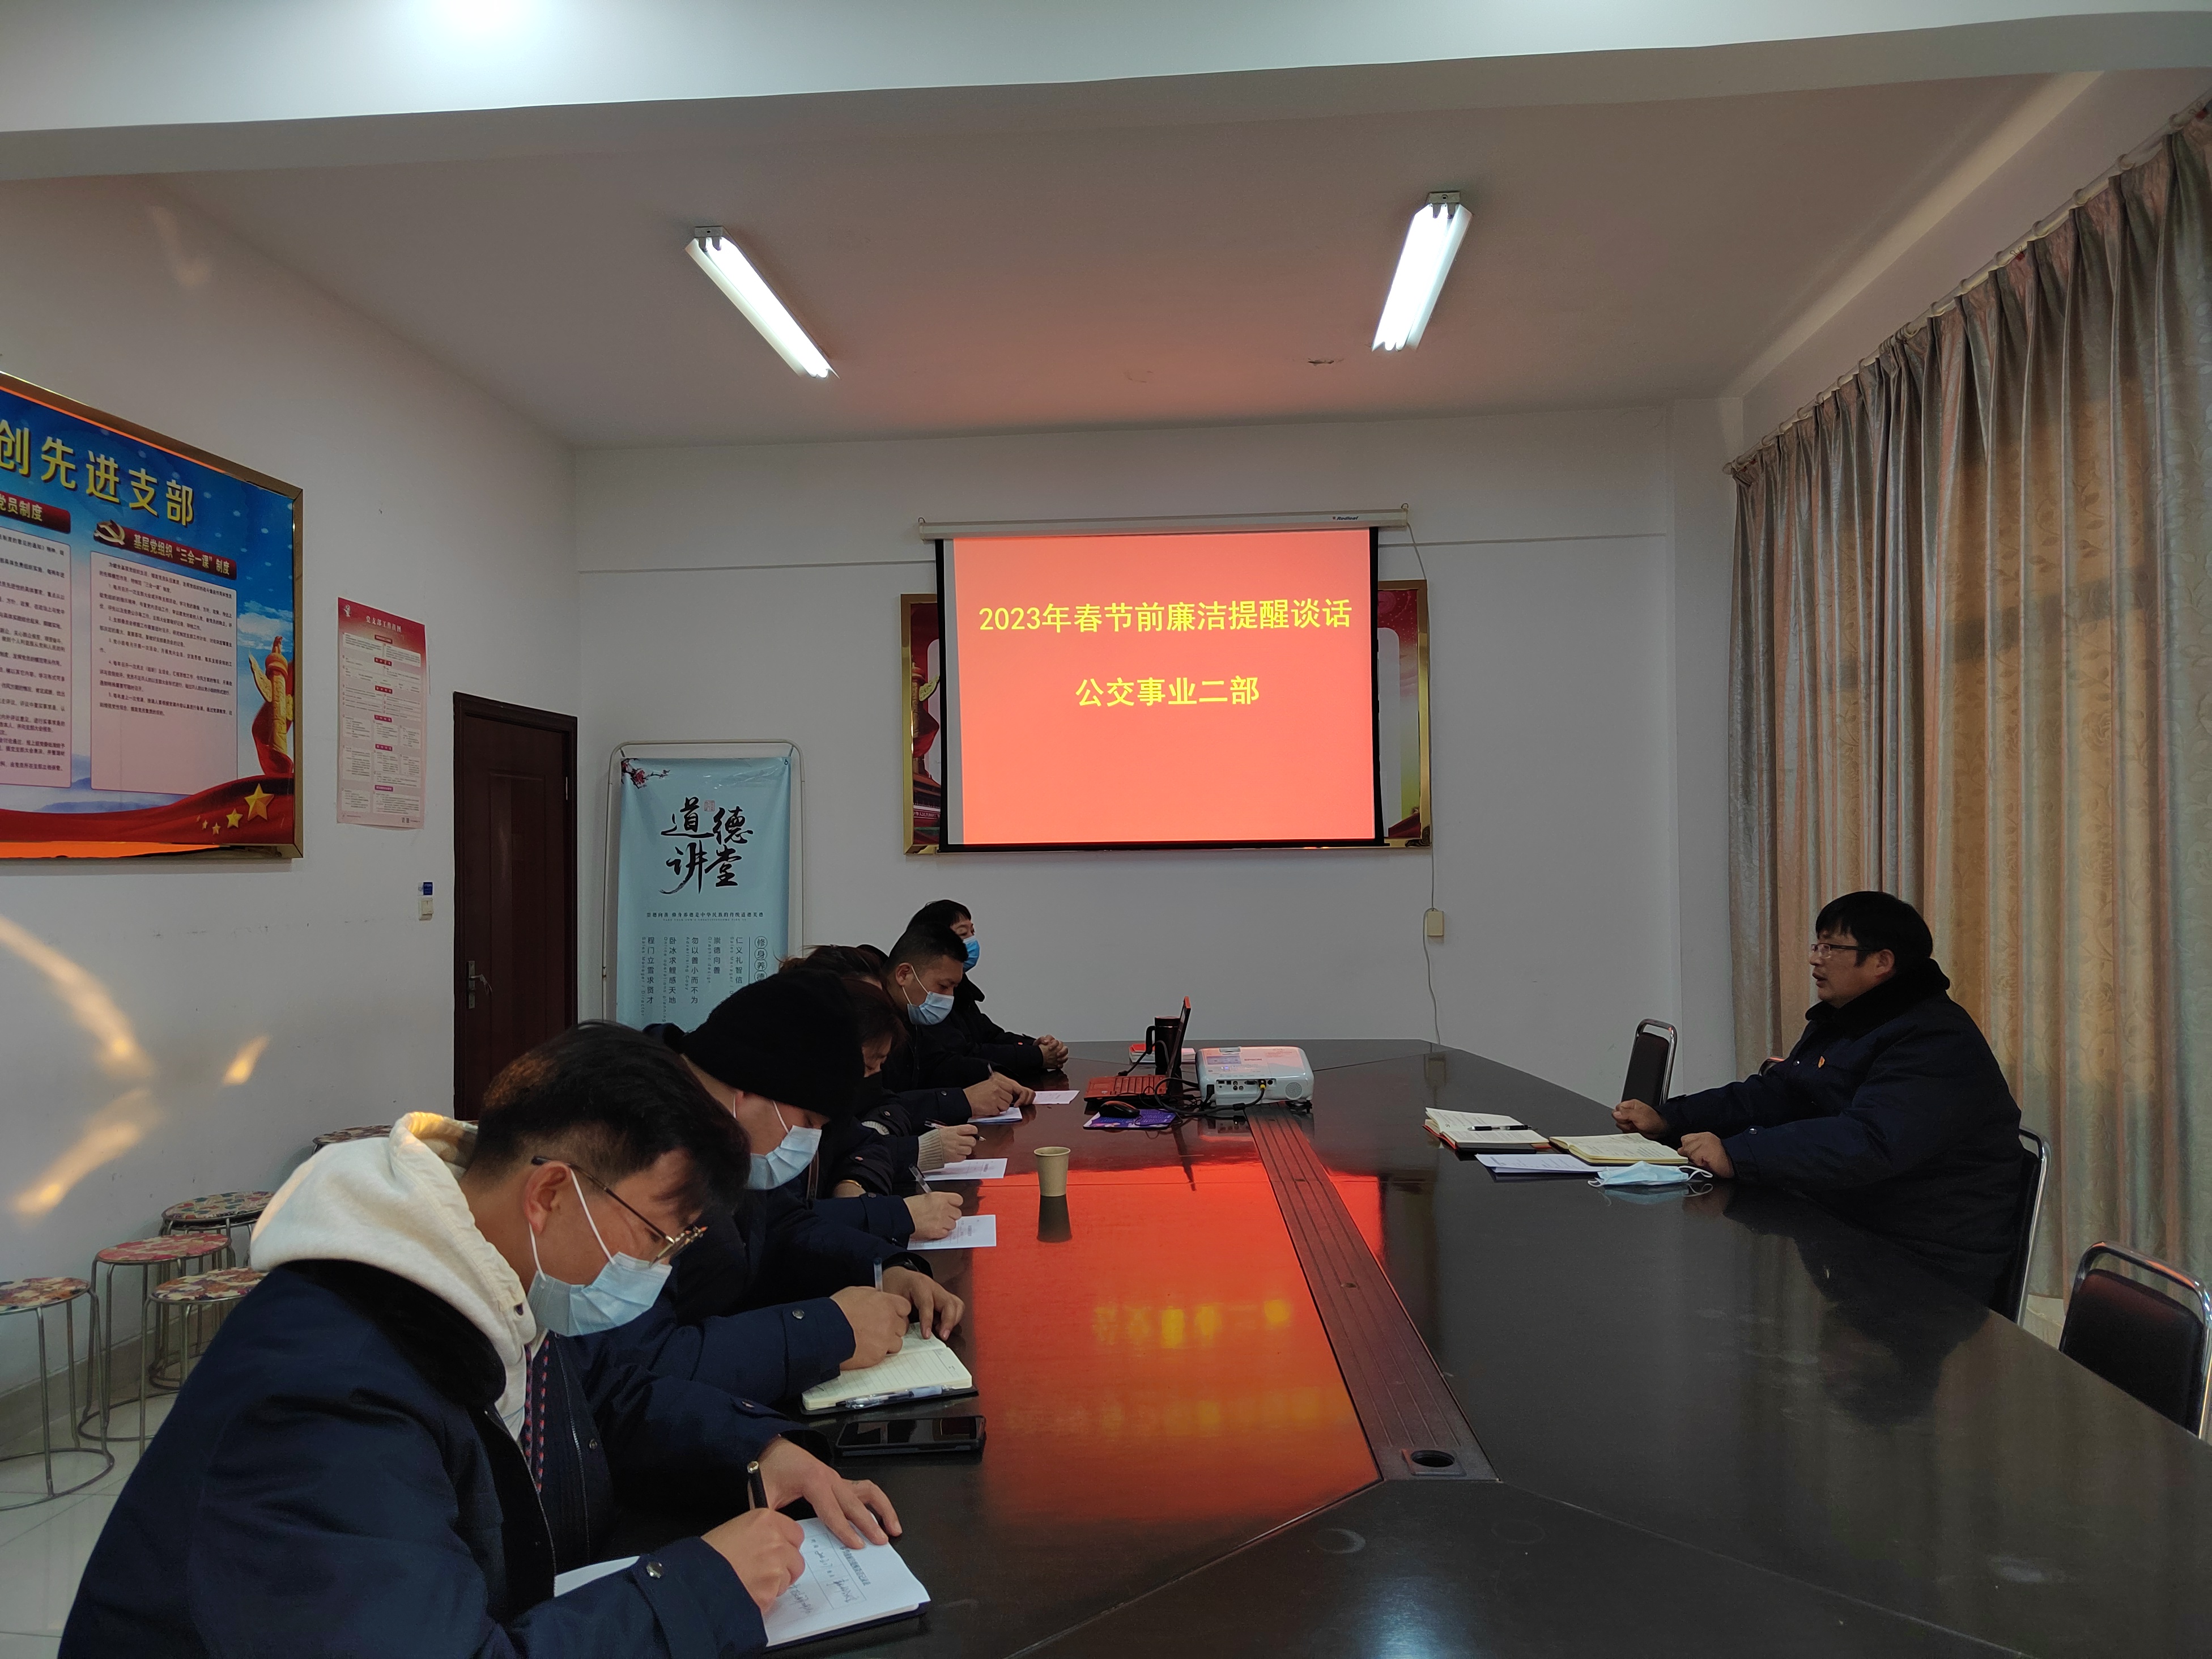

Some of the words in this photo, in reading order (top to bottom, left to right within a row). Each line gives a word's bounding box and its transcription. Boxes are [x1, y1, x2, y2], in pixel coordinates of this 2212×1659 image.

[0, 419, 194, 526] 创先进支部
[980, 599, 1351, 632] 2023年春节前廉洁提醒谈话
[1076, 675, 1259, 706] 公交事业二部
[661, 796, 753, 845] 道德
[658, 840, 742, 894] 讲堂
[646, 937, 655, 1003] 程门立雪求贤才
